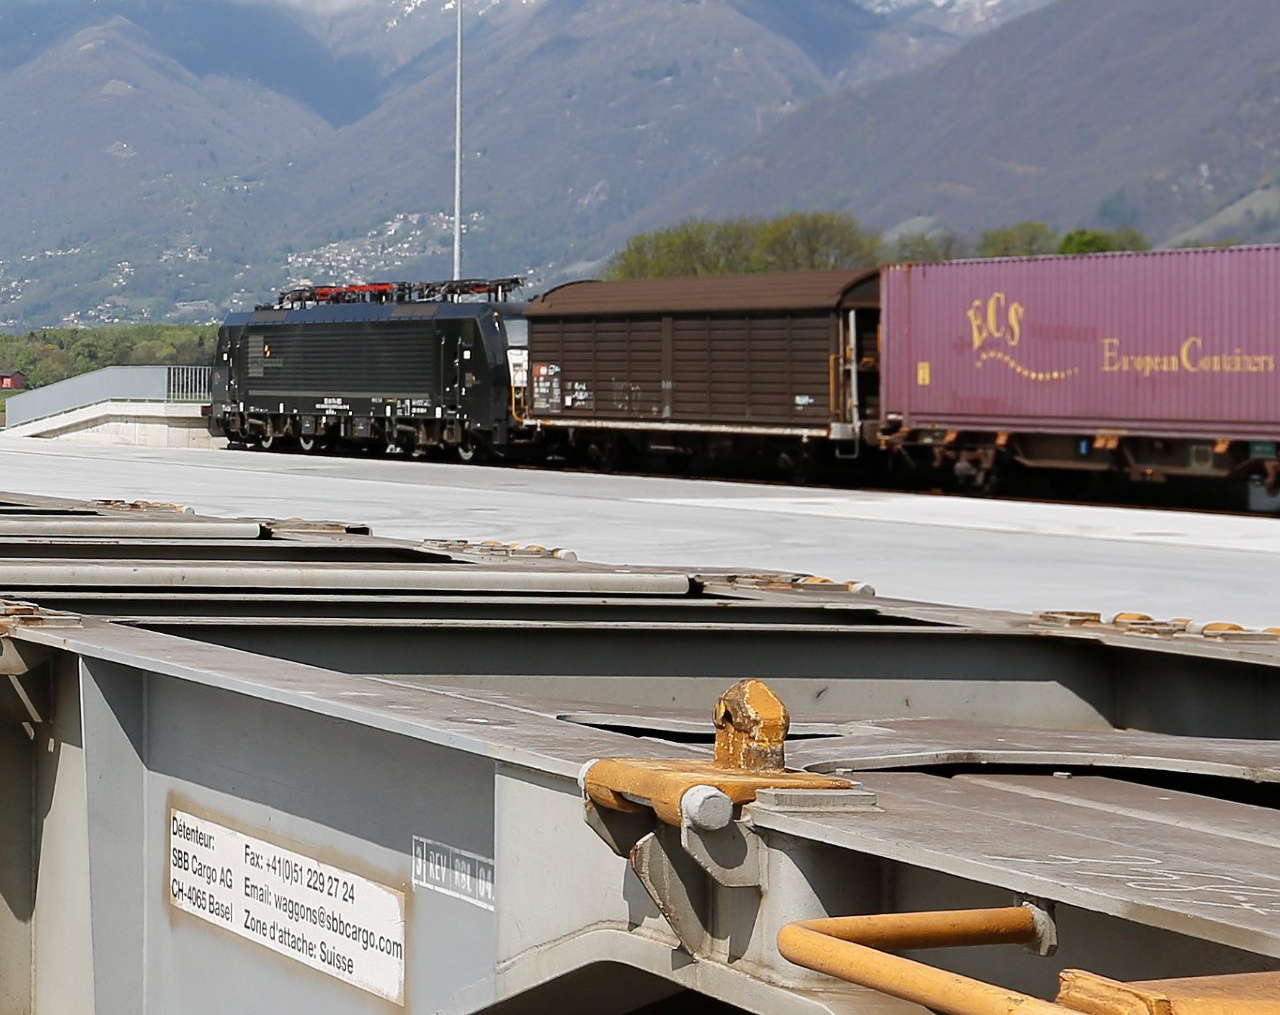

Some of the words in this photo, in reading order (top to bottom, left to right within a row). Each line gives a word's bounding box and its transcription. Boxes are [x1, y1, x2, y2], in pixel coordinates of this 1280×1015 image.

[966, 291, 1025, 351] ECS
[1101, 337, 1179, 378] European
[172, 816, 215, 851] Détenteur:
[172, 847, 190, 872] SBB
[191, 857, 217, 883] Cargo
[219, 868, 233, 890] AG
[244, 844, 264, 870] Fax:
[266, 854, 304, 887] +41(0)51
[306, 868, 325, 894] 229
[327, 875, 340, 899] 27
[342, 881, 355, 905] 24
[429, 850, 447, 883] REV
[171, 878, 207, 911] CH-4065
[208, 895, 233, 923] Basel
[244, 876, 272, 906] Email:
[274, 891, 403, 960] waggons@sbbcargo.com
[244, 909, 267, 937] Zone
[269, 921, 317, 959] d'attache:
[320, 941, 354, 974] Suisse
